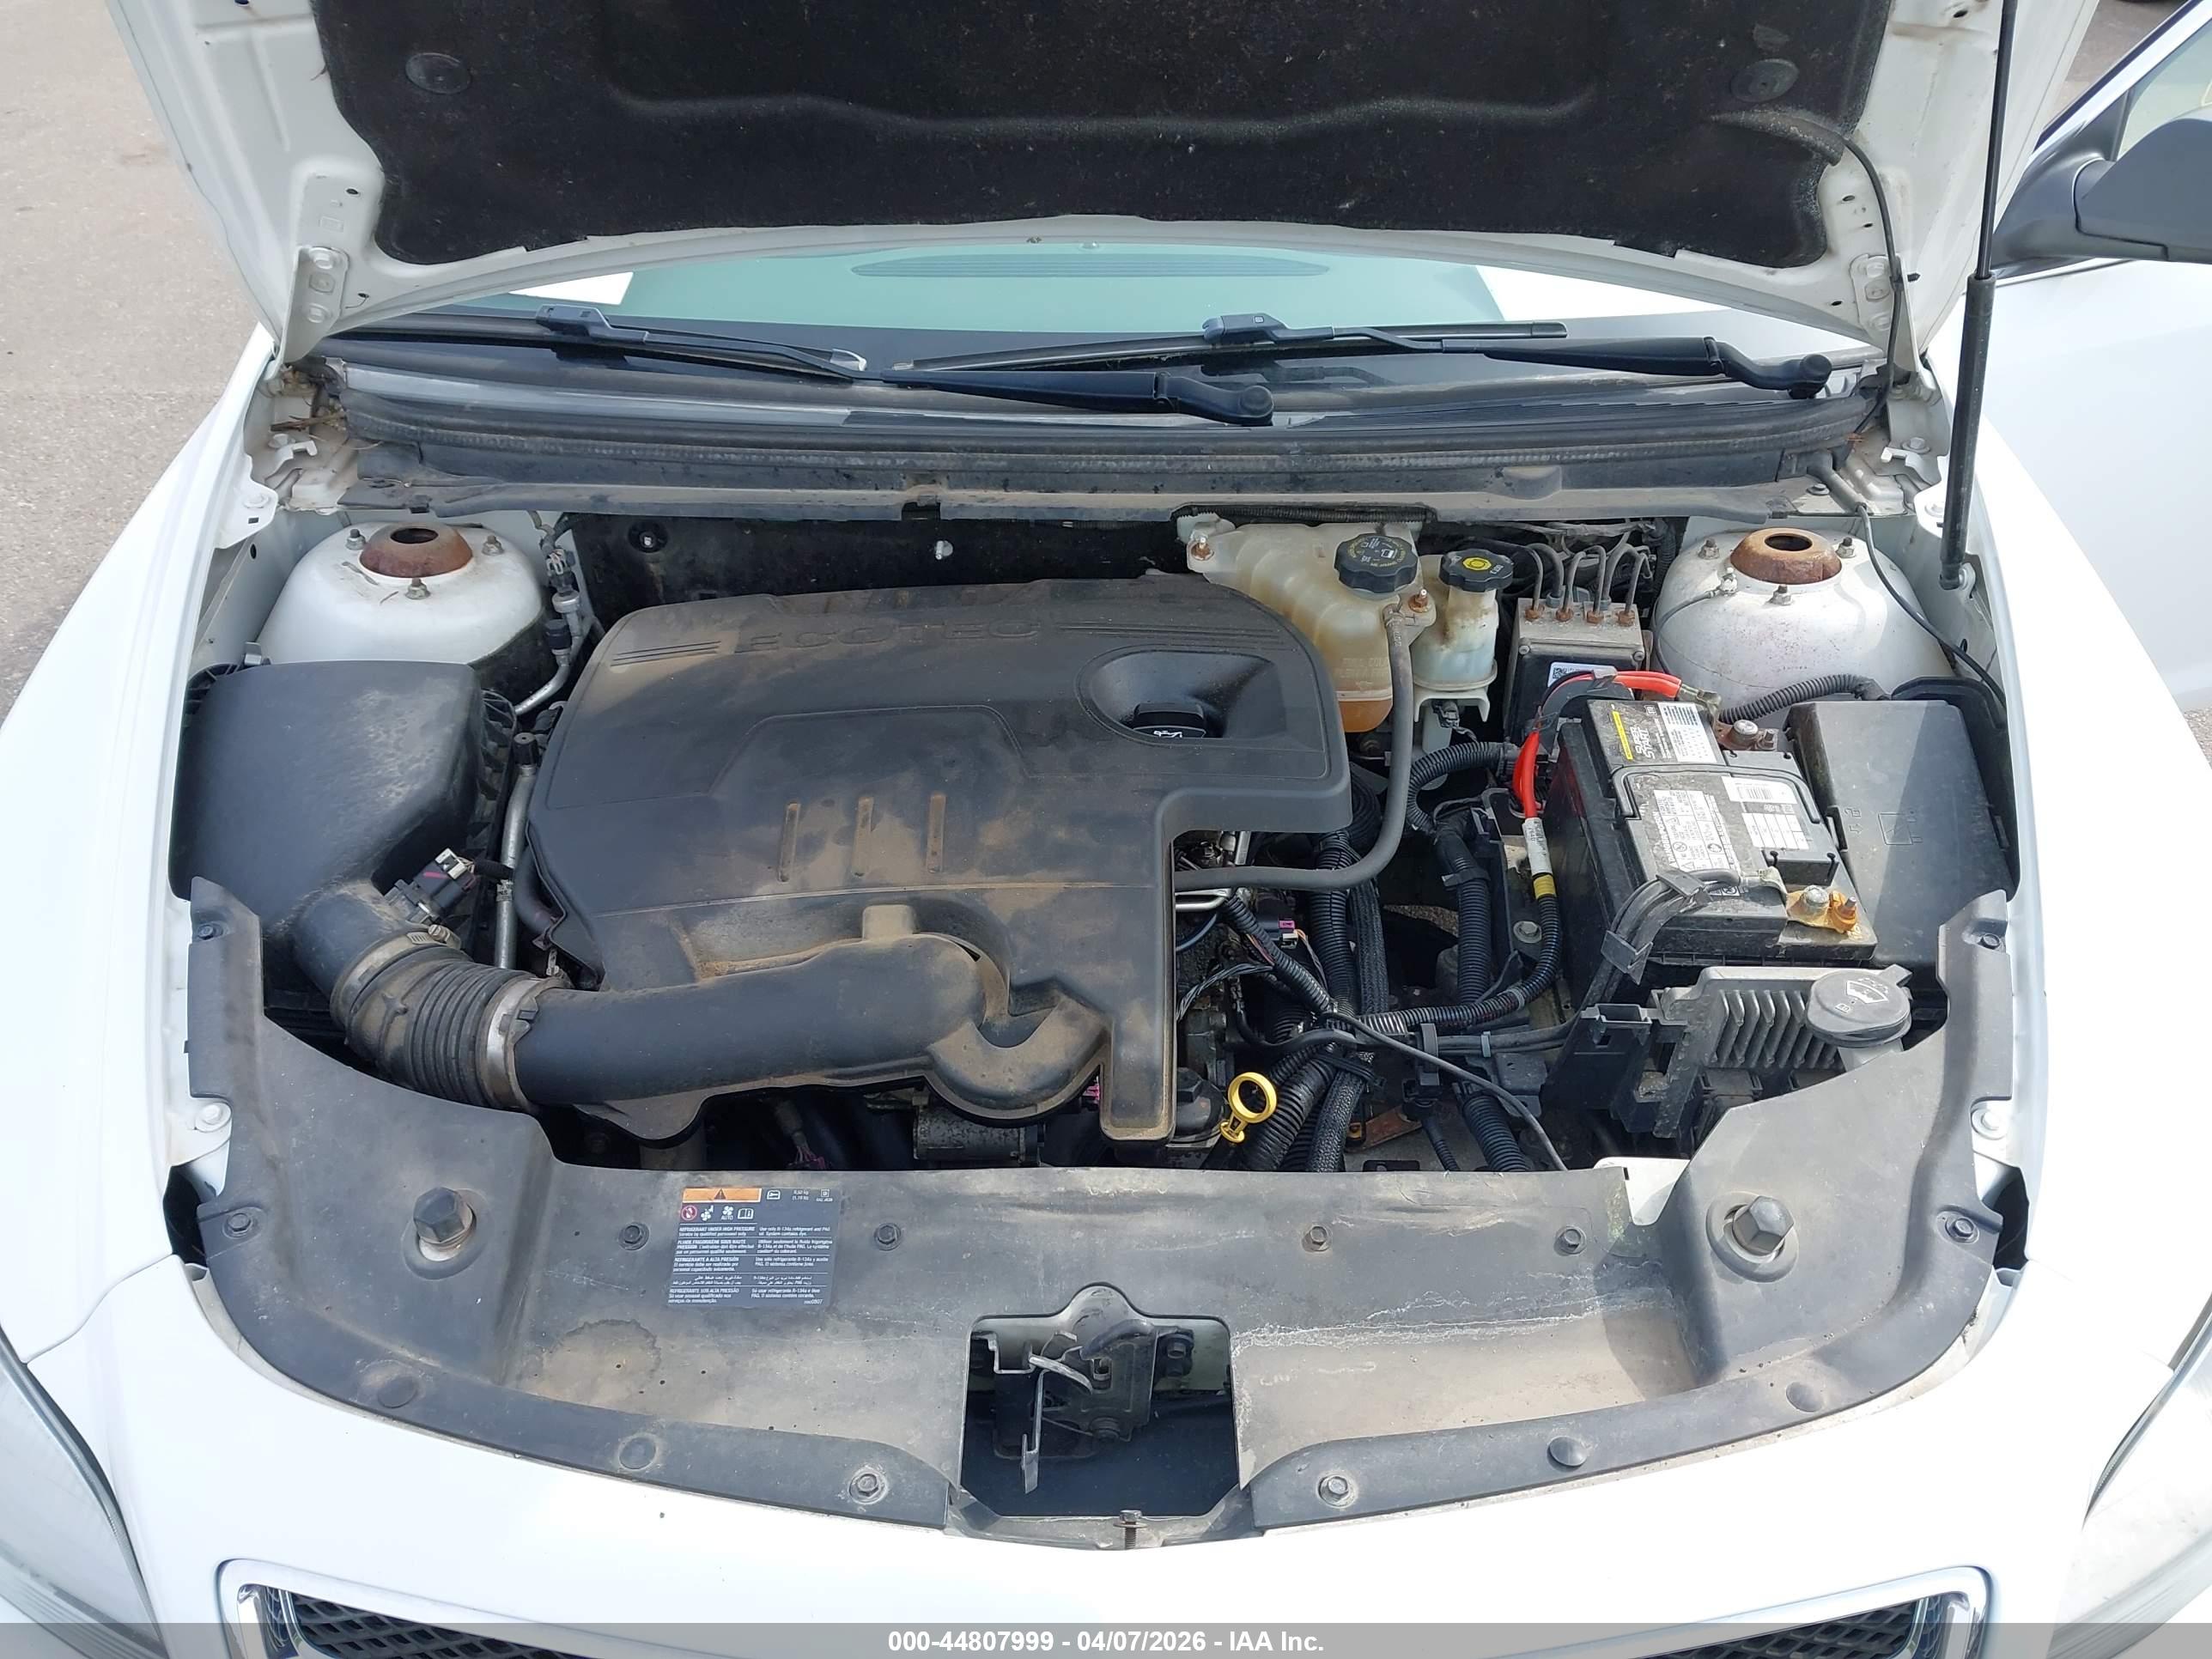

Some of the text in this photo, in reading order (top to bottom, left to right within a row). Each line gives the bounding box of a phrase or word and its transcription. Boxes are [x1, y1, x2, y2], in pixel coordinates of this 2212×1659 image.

[735, 620, 1041, 653] ECOTEC
[1630, 726, 1644, 754] SUPER
[1638, 727, 1655, 760] START
